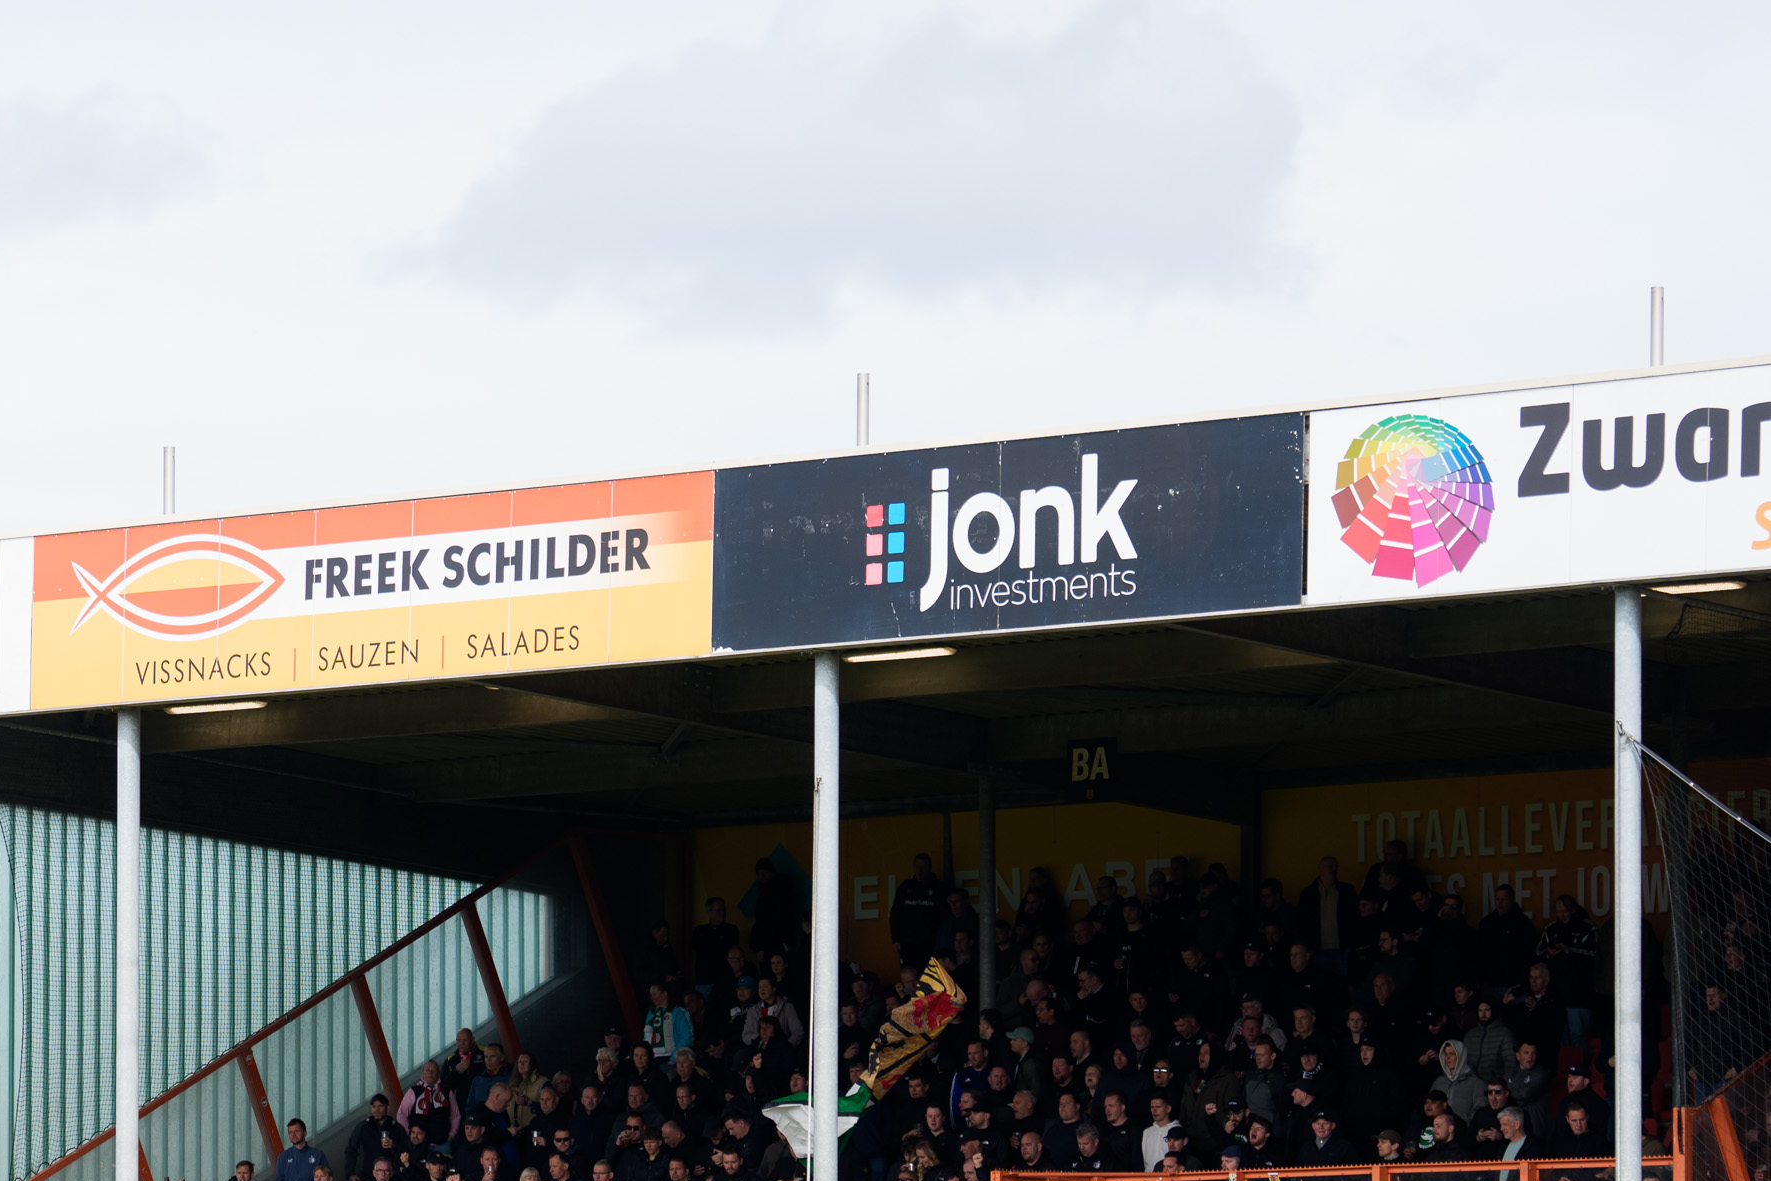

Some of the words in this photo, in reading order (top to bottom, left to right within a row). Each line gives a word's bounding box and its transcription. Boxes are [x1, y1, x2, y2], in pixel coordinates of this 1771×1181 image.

[920, 453, 1139, 613] jonk
[304, 549, 430, 601] FREEK
[443, 527, 651, 589] SCHILDER
[950, 562, 1137, 611] investments
[318, 638, 421, 672] SAUZEN
[466, 624, 582, 660] SALADES
[136, 651, 272, 686] VISSNACKS
[1071, 747, 1110, 782] BA
